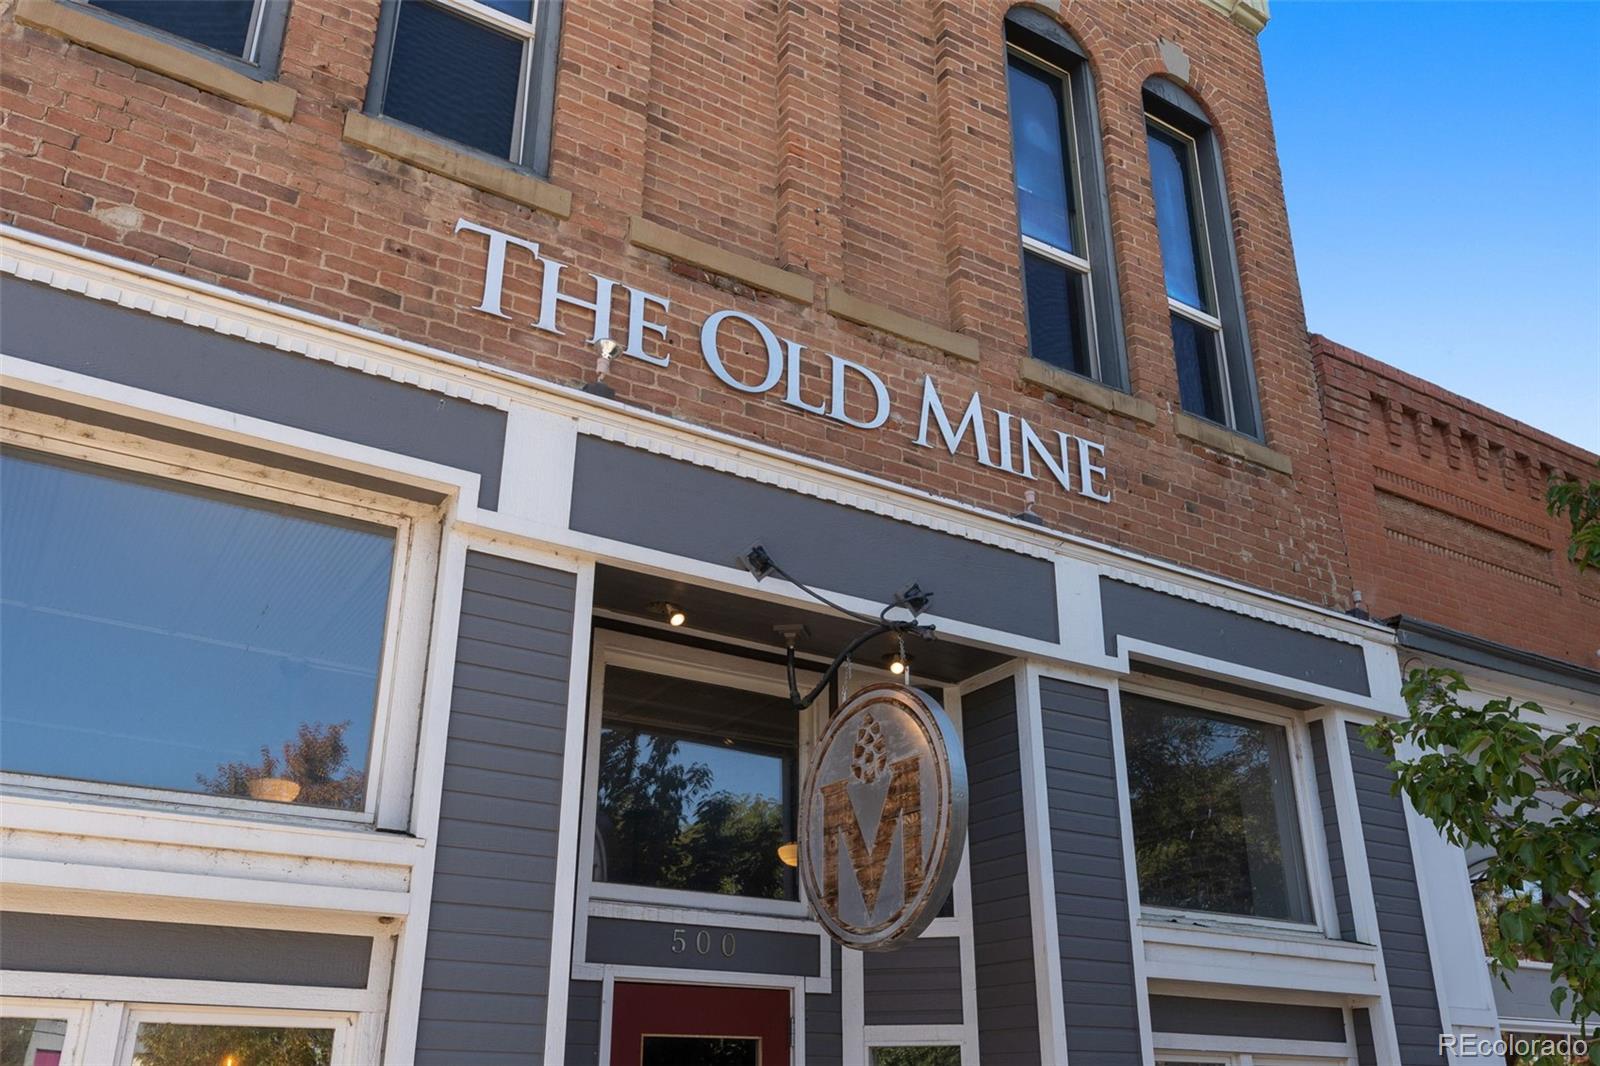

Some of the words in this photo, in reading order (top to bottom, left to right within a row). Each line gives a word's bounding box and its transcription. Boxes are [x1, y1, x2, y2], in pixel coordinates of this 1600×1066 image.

[455, 218, 671, 368] THE
[701, 309, 892, 430] OLD
[912, 374, 1112, 503] MINE
[671, 928, 736, 957] 500
